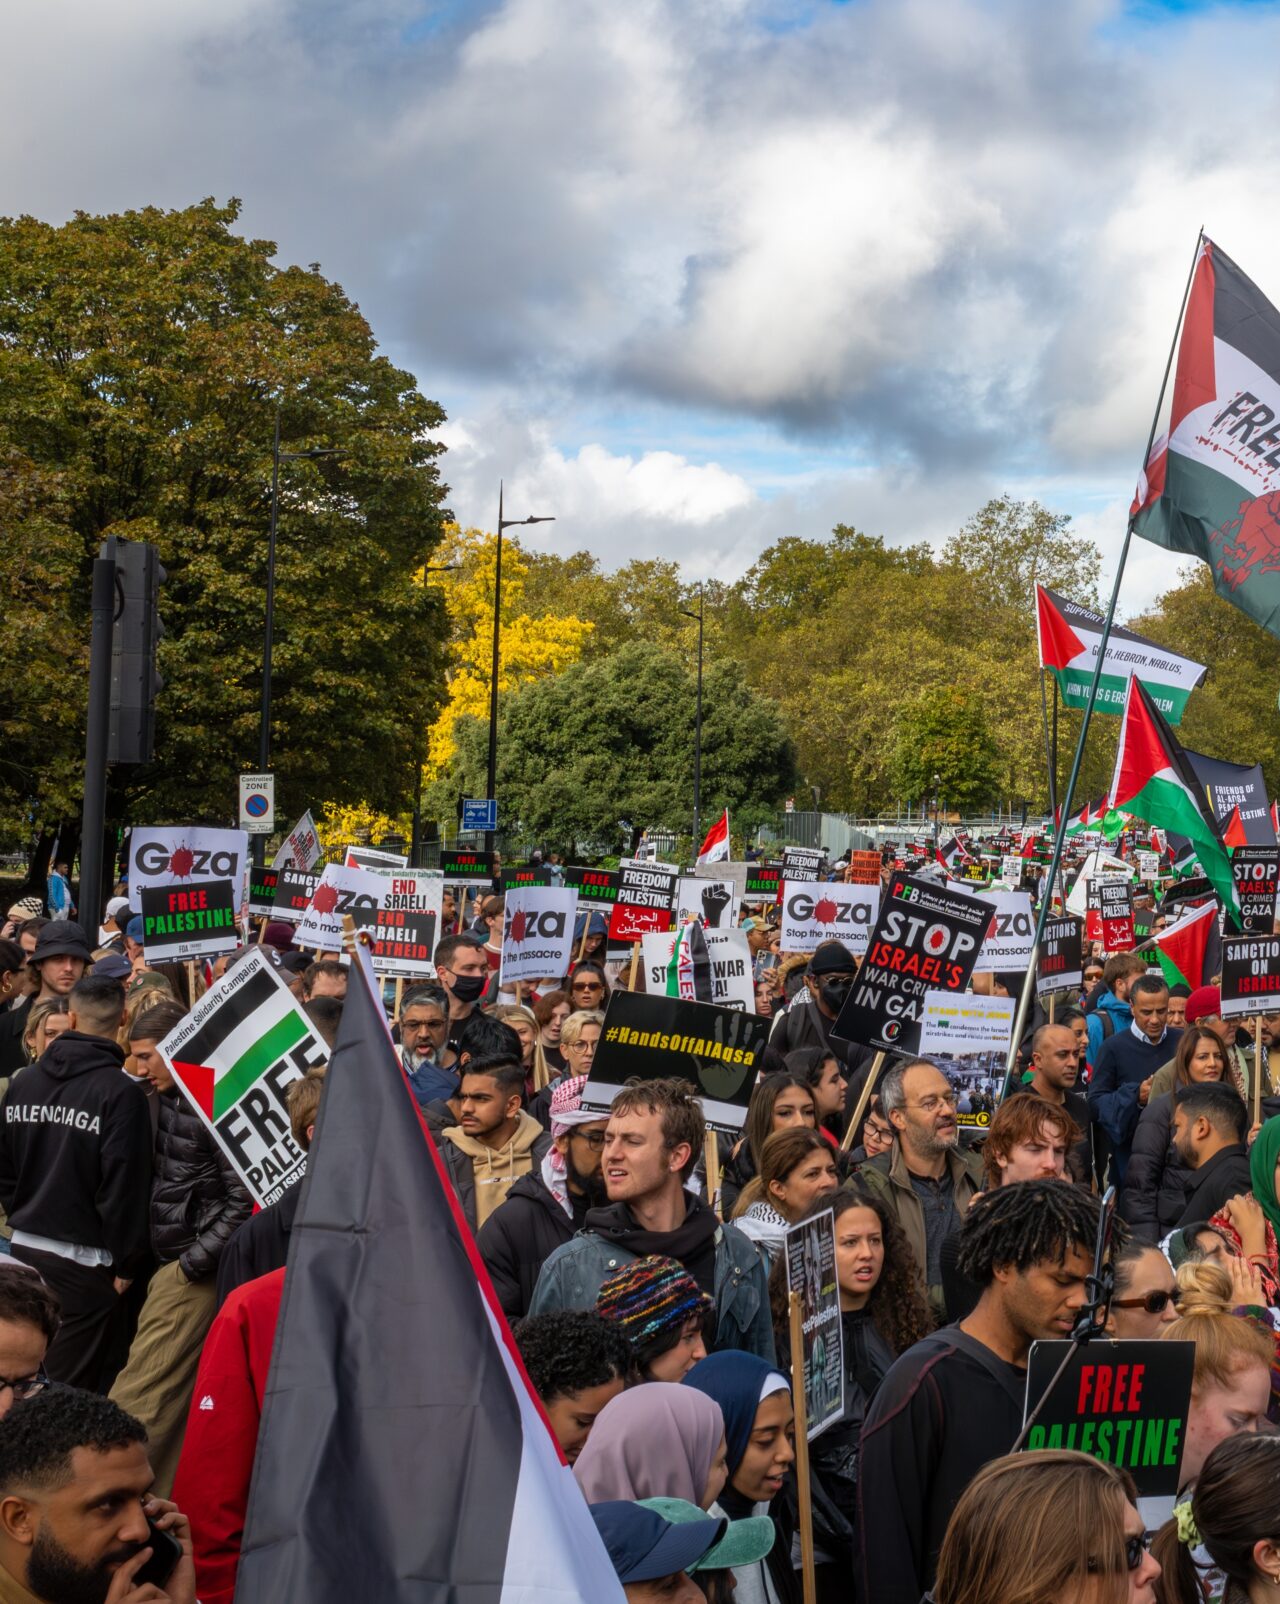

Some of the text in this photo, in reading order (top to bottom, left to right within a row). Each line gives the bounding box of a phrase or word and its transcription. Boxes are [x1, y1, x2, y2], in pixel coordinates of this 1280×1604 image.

[1064, 603, 1102, 622] SUPPORT
[1113, 650, 1182, 675] HEBRON, NABLUS,
[1111, 690, 1127, 704] EAS
[1215, 784, 1254, 795] FRIENDS OF
[1216, 795, 1247, 803] AL-AQSA
[1239, 807, 1266, 820] LESTINE
[135, 841, 239, 877] Gza
[458, 856, 476, 865] FREE
[629, 861, 670, 872] Socialist Worker
[786, 855, 819, 868] FREEDOM
[444, 863, 487, 873] PALESTINE
[758, 870, 778, 880] FREE
[782, 868, 818, 882] PALESTINE
[1234, 863, 1277, 881] STOP
[283, 872, 321, 886] SANCT
[515, 872, 535, 881] FREE
[583, 873, 609, 886] FREE
[623, 870, 671, 889] FREEDOM
[392, 879, 416, 895] END
[747, 880, 778, 890] PALESTI
[892, 882, 920, 903] PFB
[1102, 886, 1128, 900] FREEDOM
[1238, 881, 1275, 894] RAEL'S
[168, 890, 208, 912] FREE
[384, 894, 427, 910] SRAELI
[617, 889, 671, 908] PALESTINE
[1247, 894, 1274, 903] CRIMES
[624, 908, 658, 922] الحرية
[787, 893, 872, 925] Gza
[919, 899, 945, 912] Palestinian
[944, 906, 960, 917] Forum
[965, 912, 982, 923] Britain
[1103, 904, 1131, 918] PALESTINE
[1242, 905, 1272, 916] GAZA
[145, 907, 234, 936] PALESTINE
[302, 918, 318, 930] the
[377, 911, 405, 926] END
[996, 912, 1032, 937] za
[786, 928, 808, 939] Stop
[809, 929, 823, 938] the
[880, 911, 975, 960] STOP
[374, 941, 428, 959] RTHEID
[987, 946, 1033, 957] massacr
[1047, 940, 1058, 956] ON
[507, 950, 562, 963] the massacre
[651, 959, 745, 983] ST WAR
[679, 941, 695, 1001] PALES
[869, 941, 964, 989] ISRAEL'S
[1252, 959, 1268, 975] ON
[864, 966, 948, 996] WAR CRI
[1238, 975, 1280, 992] ISRAEL
[854, 985, 882, 1010] IN
[164, 957, 261, 1057] Palestine Solidarity Campaign
[926, 1021, 937, 1029] The
[980, 1025, 990, 1033] the
[605, 1025, 755, 1066] #HandsOffAlAqsa
[5, 1104, 101, 1136] BALENCIAGA
[264, 1186, 285, 1208] END
[1077, 1364, 1145, 1414] FREE
